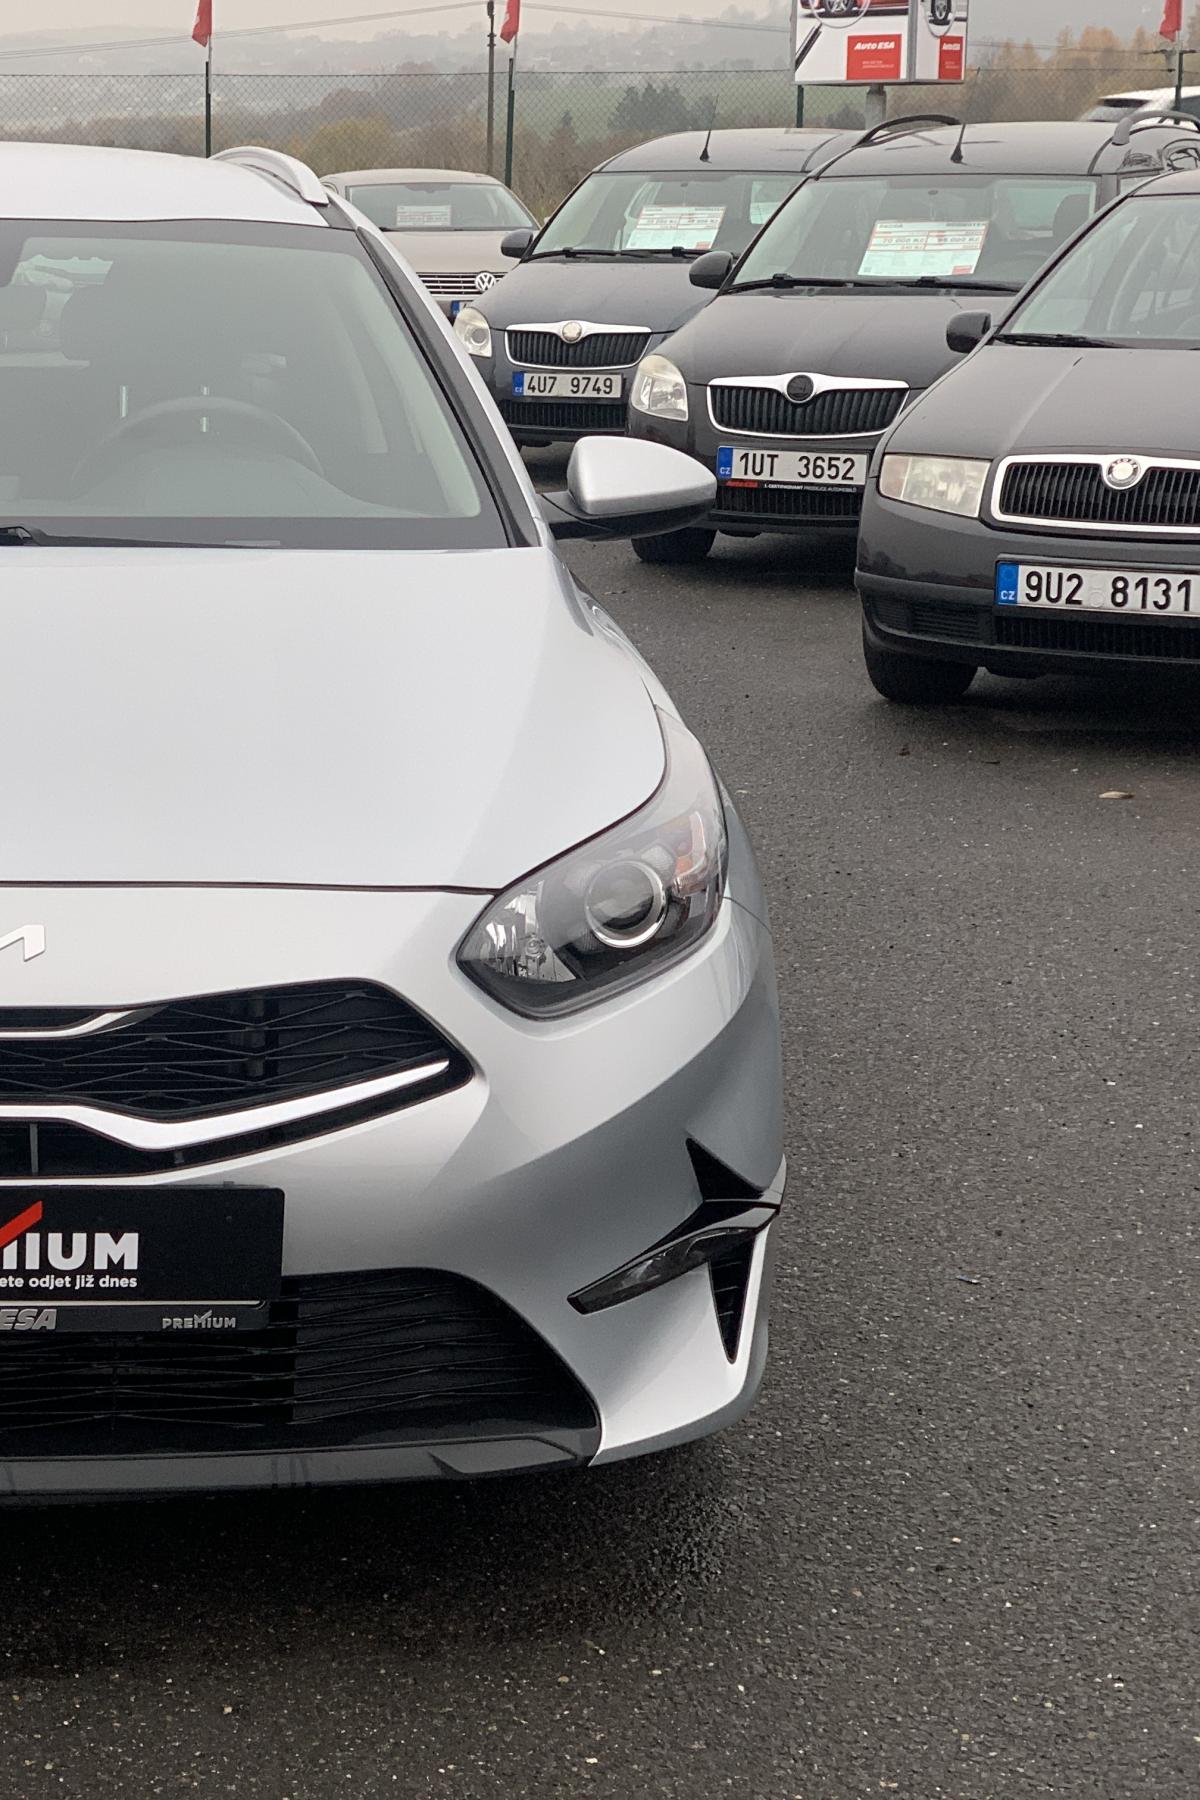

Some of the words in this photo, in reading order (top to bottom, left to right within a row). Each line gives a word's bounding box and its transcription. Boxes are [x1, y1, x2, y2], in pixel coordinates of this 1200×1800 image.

[854, 41, 877, 51] Auto
[527, 375, 558, 394] 4U7
[570, 376, 613, 395] 9749
[719, 466, 731, 475] CZ
[739, 452, 779, 477] 1UT
[797, 455, 855, 481] 3652
[1000, 589, 1016, 601] CZ
[1025, 571, 1084, 606] 9U2
[1110, 575, 1192, 612] 8131
[29, 1274, 71, 1290] odjet
[74, 1274, 94, 1290] již
[98, 1274, 138, 1288] dnes
[162, 1312, 236, 1329] PREMIUM
